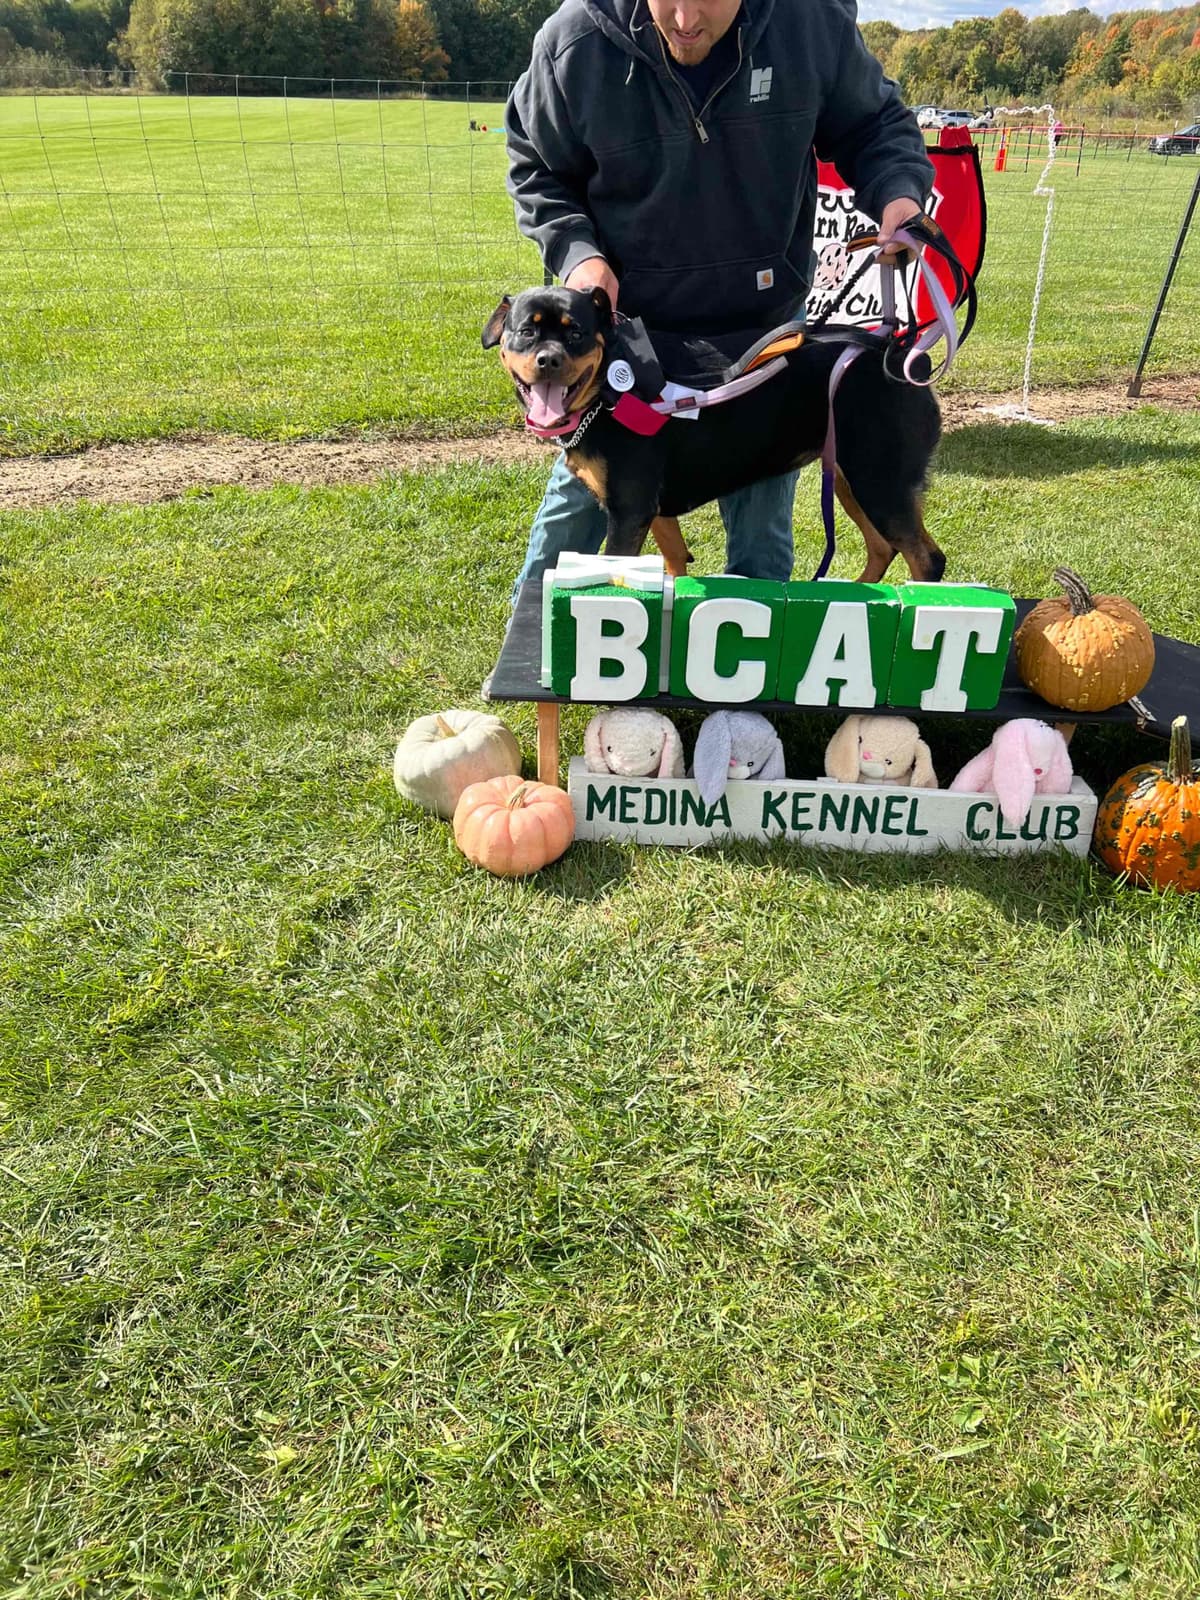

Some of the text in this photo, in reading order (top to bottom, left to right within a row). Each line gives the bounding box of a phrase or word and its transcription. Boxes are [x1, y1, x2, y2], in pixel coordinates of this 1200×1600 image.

[845, 293, 898, 317] Clu
[569, 596, 1005, 713] BCAT
[586, 784, 1081, 842] MEDINA KENNEL CLUB
